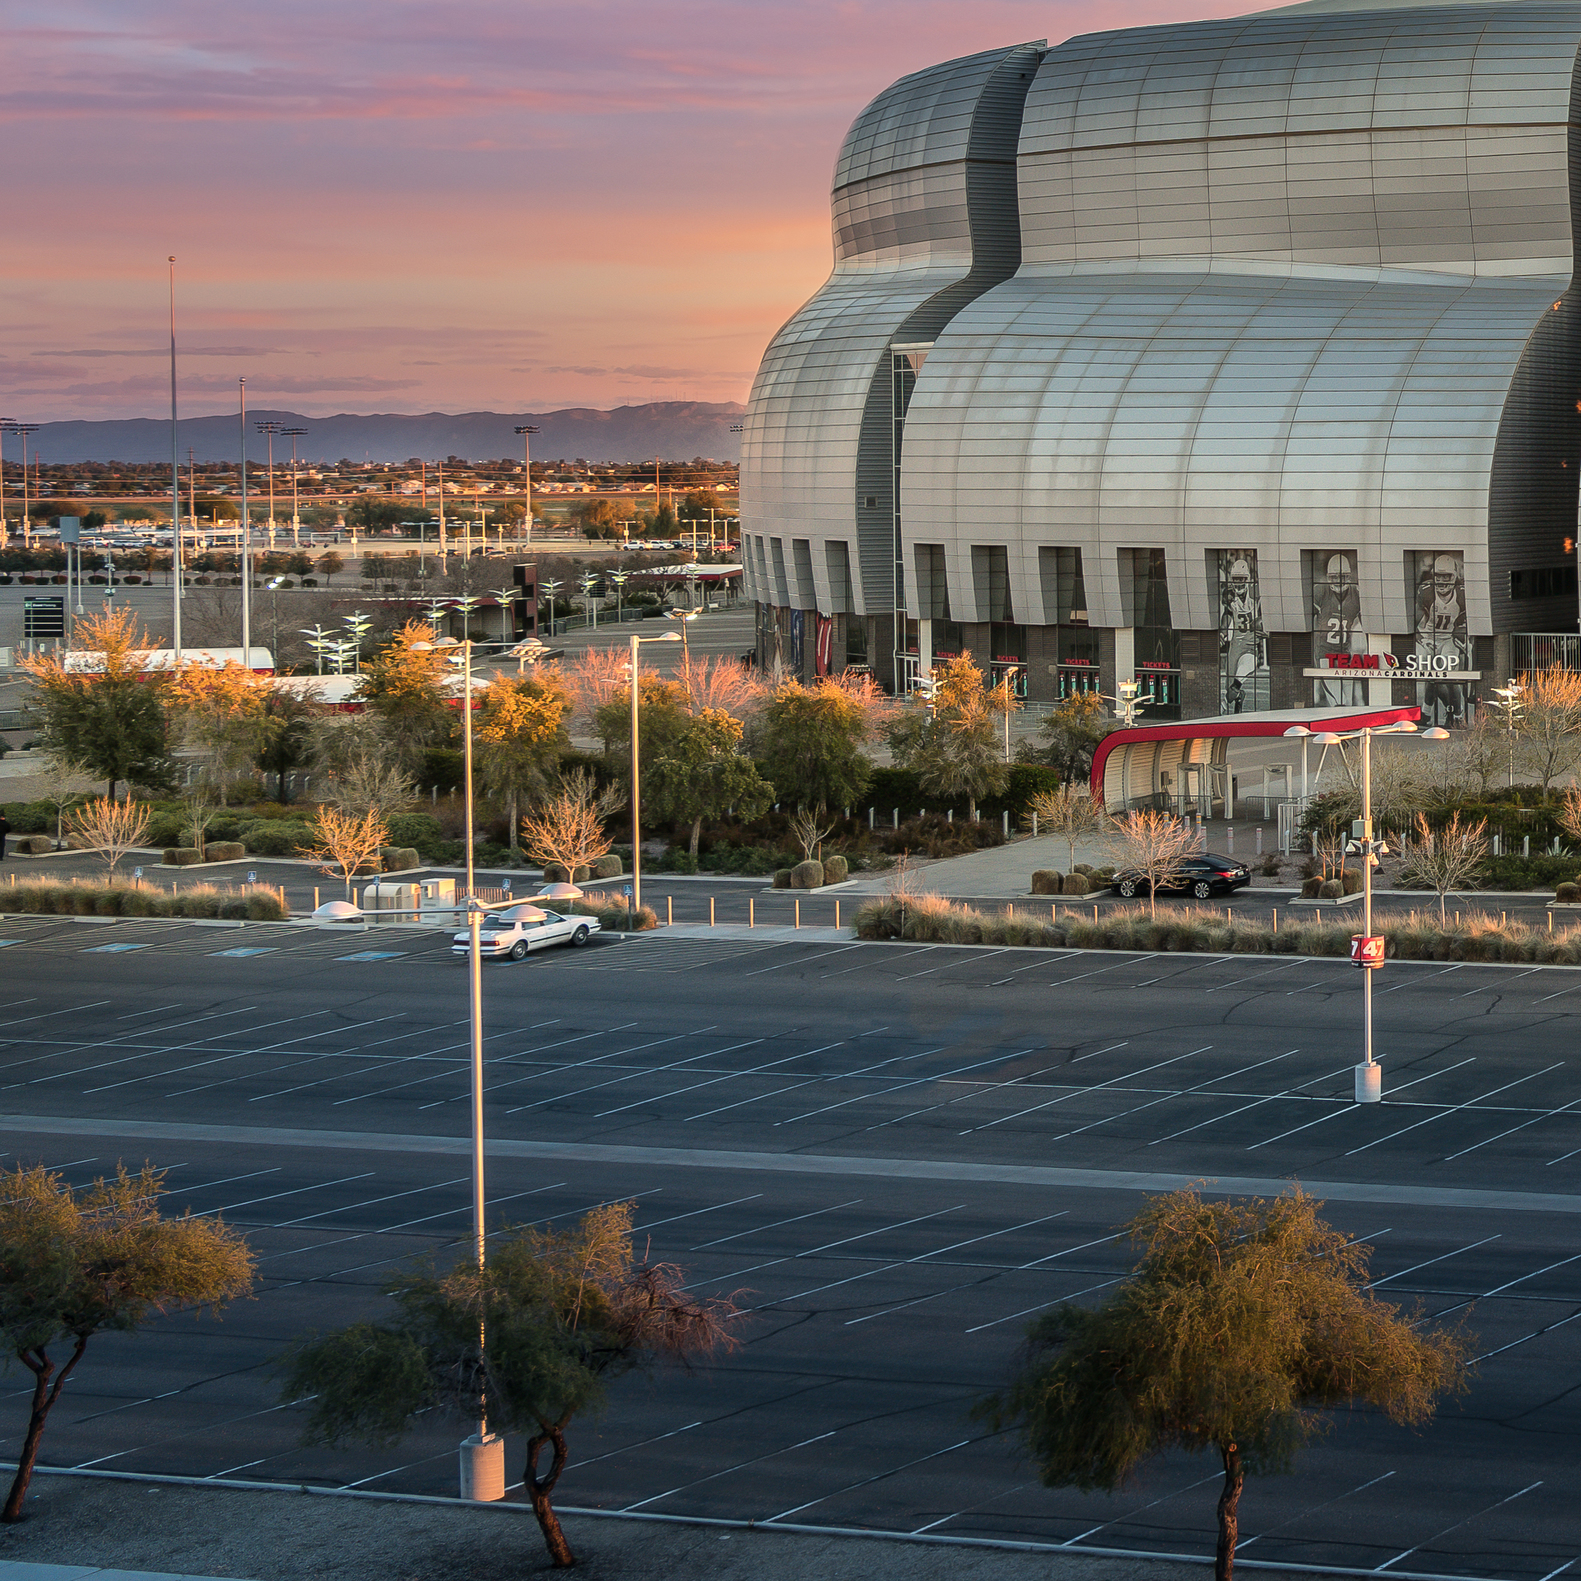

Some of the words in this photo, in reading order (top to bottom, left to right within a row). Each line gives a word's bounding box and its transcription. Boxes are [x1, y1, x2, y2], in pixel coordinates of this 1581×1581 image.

[1326, 617, 1348, 644] 21
[1142, 661, 1171, 669] TICKETS
[1325, 653, 1379, 669] TEAM
[1406, 654, 1460, 671] SHOP
[1362, 940, 1384, 957] 47
